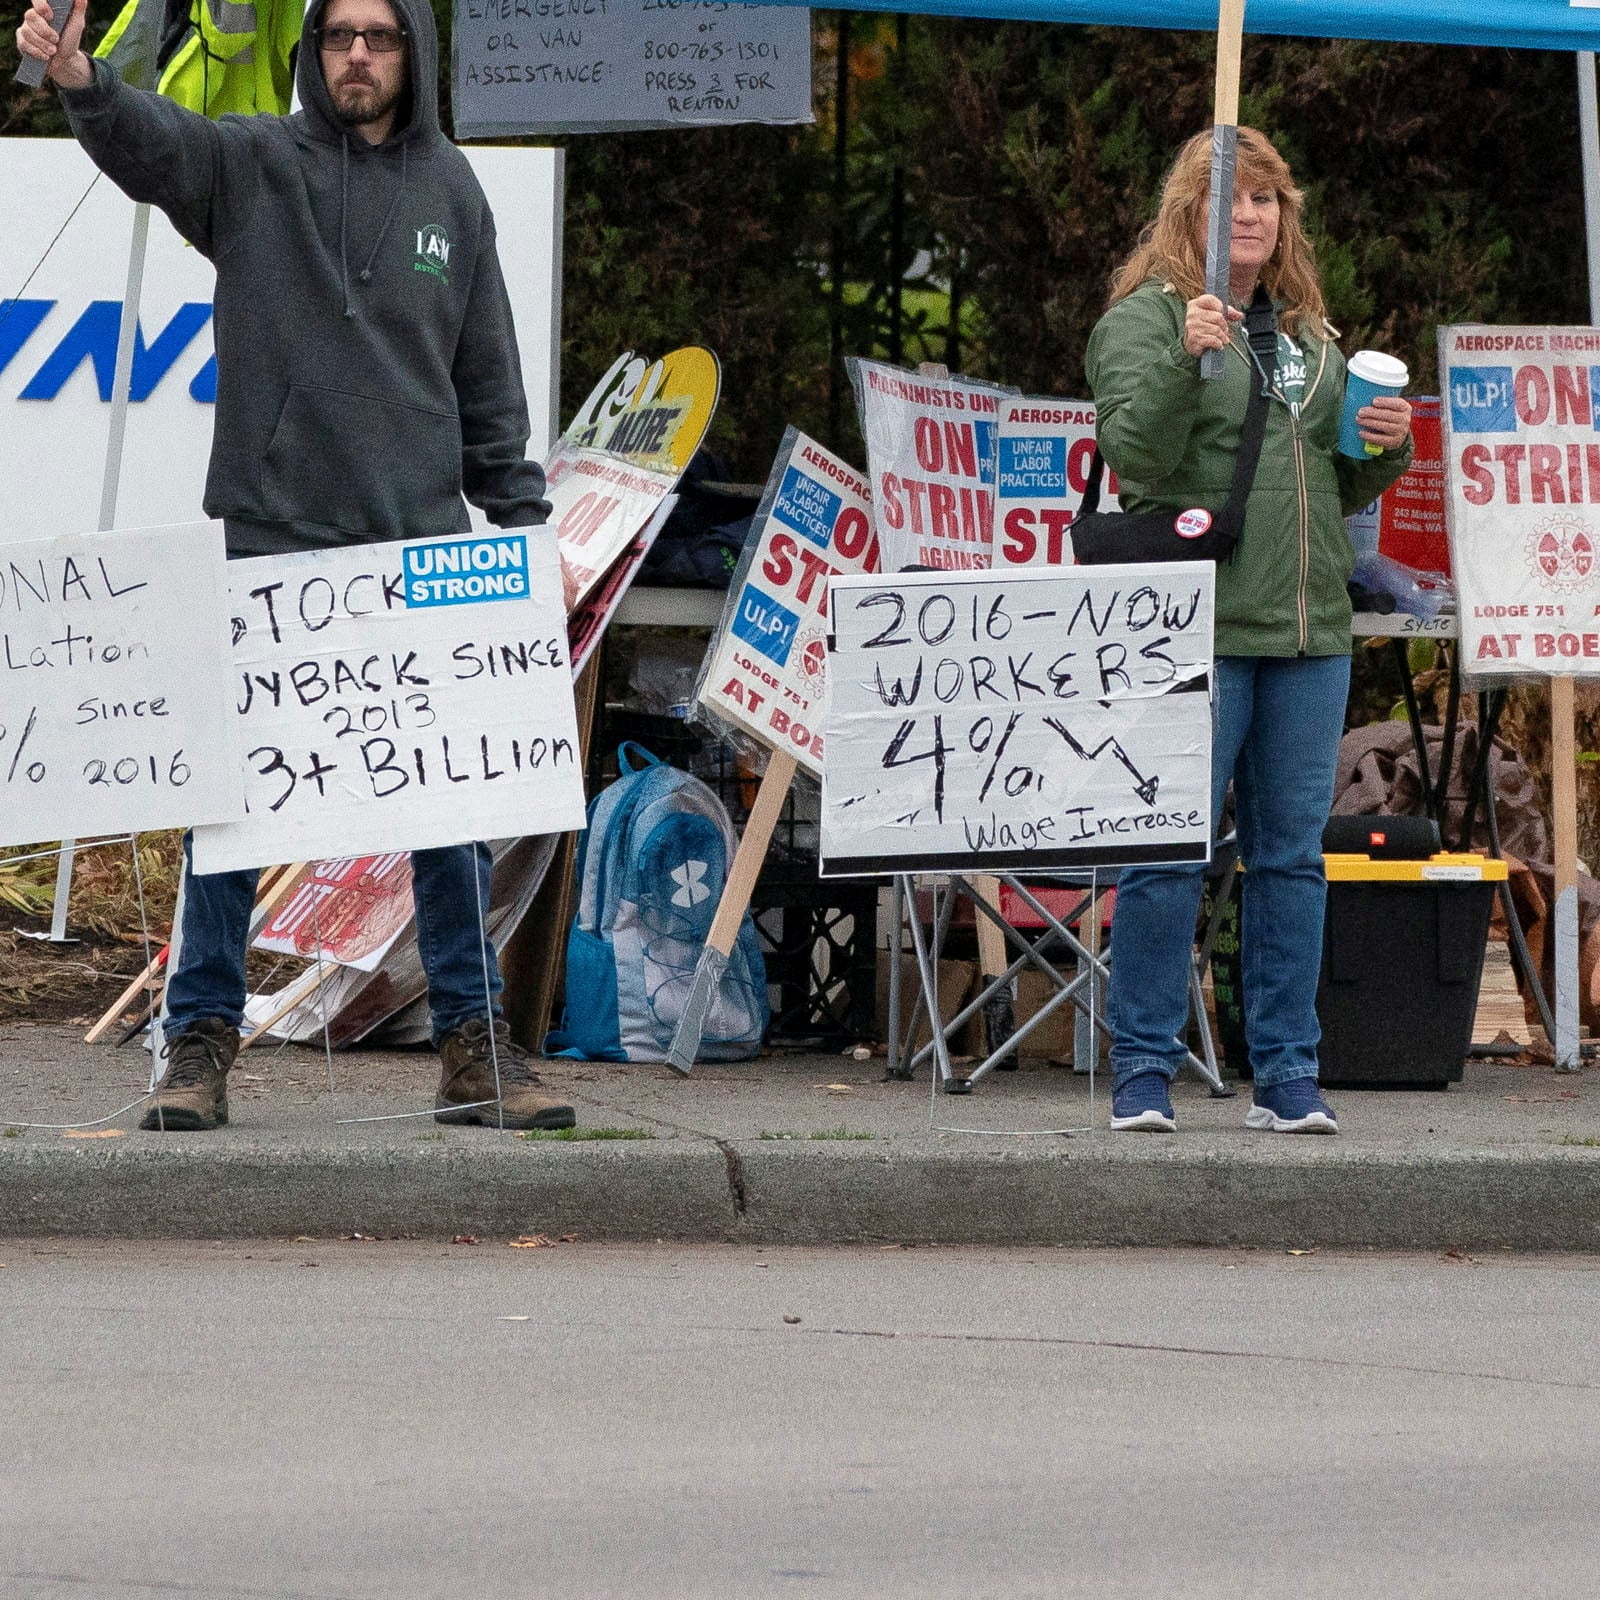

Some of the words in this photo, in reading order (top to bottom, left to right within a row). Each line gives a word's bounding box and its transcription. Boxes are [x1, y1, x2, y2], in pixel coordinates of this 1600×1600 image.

[487, 34, 518, 51] OR
[540, 29, 583, 49] VAN
[643, 41, 780, 61] 800-763-1301
[644, 71, 697, 92] PRESS
[736, 72, 776, 91] FOR
[668, 94, 741, 112] RENTON
[1455, 335, 1544, 351] AEROSPACE
[867, 370, 966, 411] MACHINISTS
[1456, 382, 1509, 410] ULP!
[1514, 364, 1592, 426] ON
[605, 407, 683, 454] MORE
[913, 416, 977, 478] ON
[1012, 440, 1053, 456] UNFAIR
[1000, 473, 1065, 488] PRACTICES!
[1014, 456, 1052, 471] LABOR
[791, 491, 824, 519] LABOR
[795, 475, 831, 507] UNFAIR
[558, 491, 621, 547] ON
[777, 495, 832, 540] PRACTICES!
[408, 542, 523, 576] UNION
[411, 574, 525, 603] STRONG
[231, 574, 406, 647] TOCK
[743, 599, 790, 645] ULP!
[1474, 604, 1529, 618] LODGE
[1534, 604, 1566, 617] 751
[452, 638, 564, 679] SINCE
[1476, 633, 1523, 659] AT
[733, 652, 780, 690] LODGE
[783, 686, 810, 711] 751
[873, 636, 1177, 707] WORKERS
[721, 677, 763, 714] AT
[322, 693, 437, 738] 2013
[83, 750, 191, 787] 2016
[963, 816, 1055, 852] Wage
[1066, 807, 1205, 842] Increase
